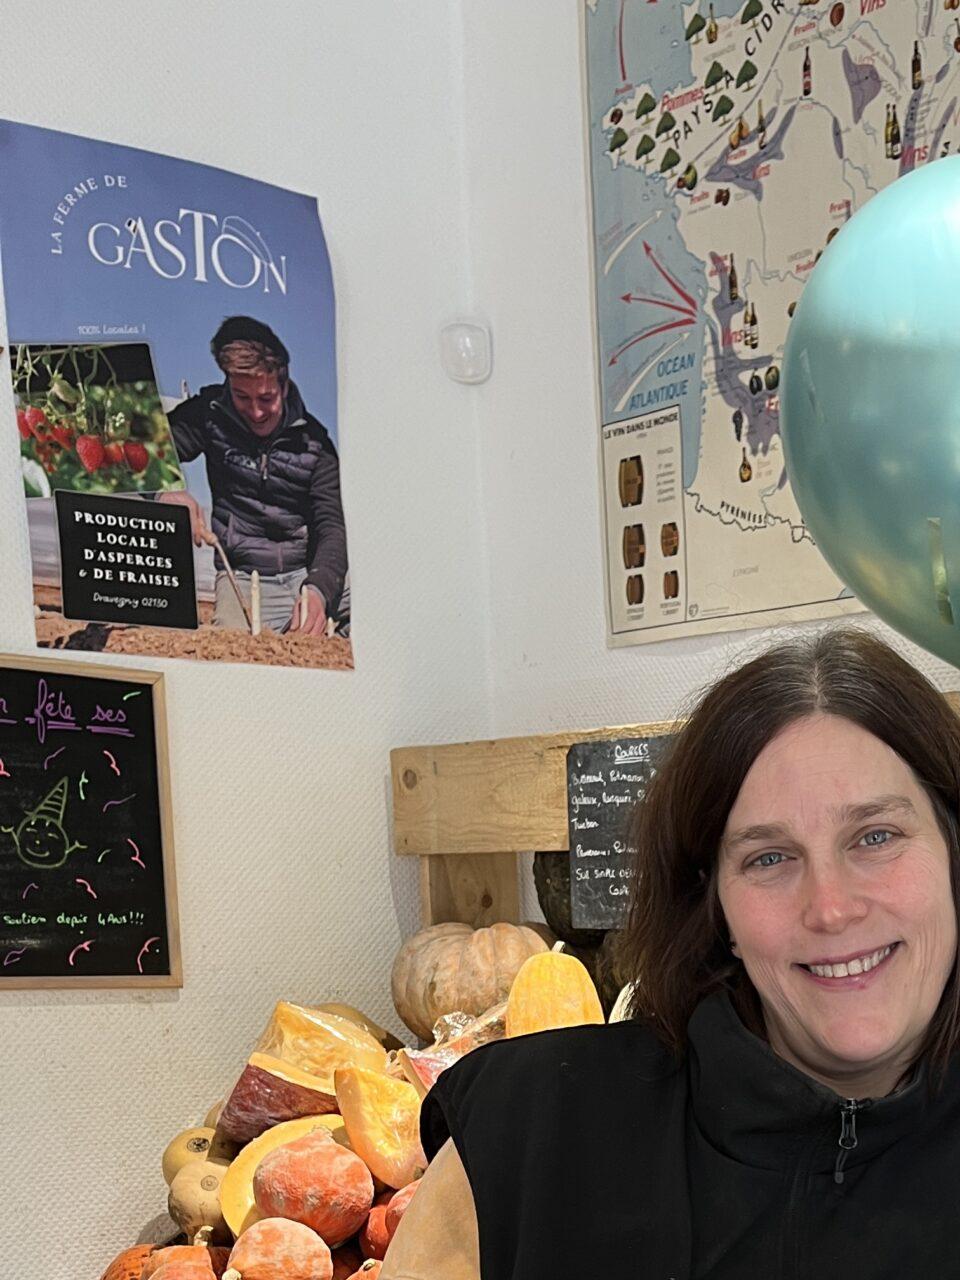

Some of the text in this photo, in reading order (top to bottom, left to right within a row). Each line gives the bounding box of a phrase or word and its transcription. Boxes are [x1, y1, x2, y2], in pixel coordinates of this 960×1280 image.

[51, 175, 128, 255] LA FERME DE
[88, 208, 287, 295] GASTON
[629, 380, 689, 412] ATLANTIQUE
[74, 511, 176, 533] PRODUCTION
[97, 532, 158, 549] LOCALE
[84, 549, 172, 569] D'ASPERGES
[93, 568, 114, 581] DE
[119, 571, 179, 588] FRAISES
[91, 704, 127, 722] ses
